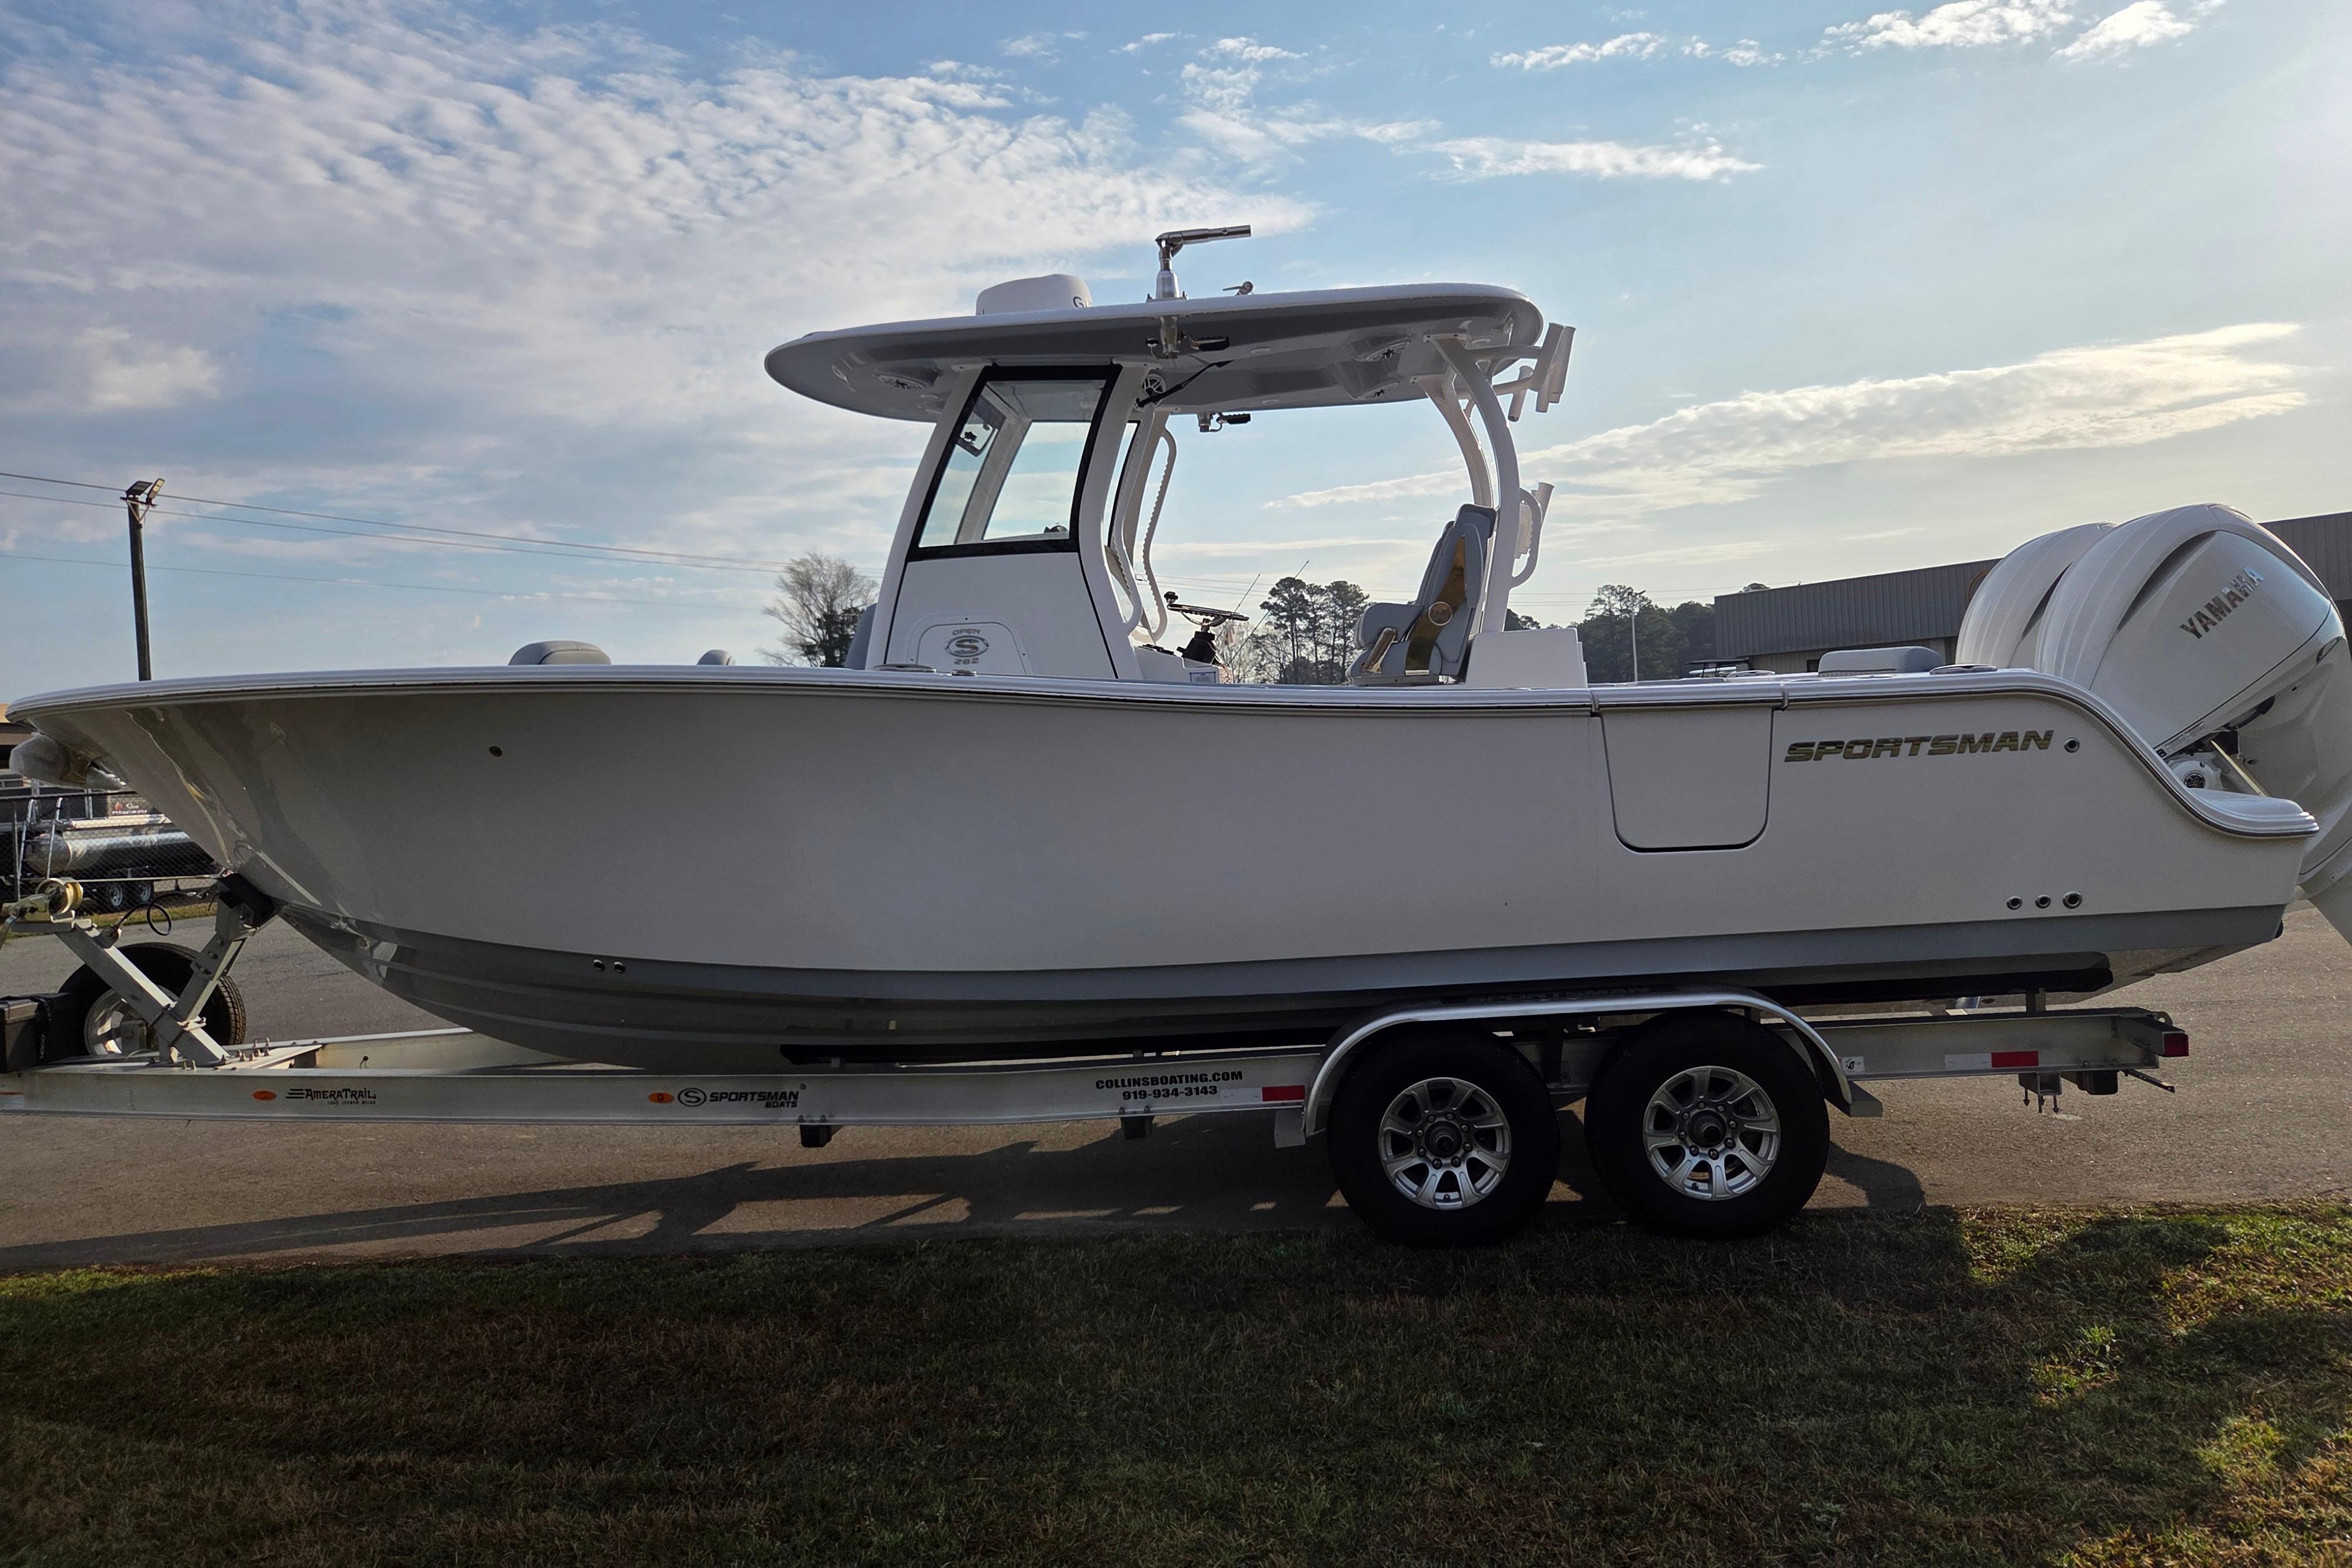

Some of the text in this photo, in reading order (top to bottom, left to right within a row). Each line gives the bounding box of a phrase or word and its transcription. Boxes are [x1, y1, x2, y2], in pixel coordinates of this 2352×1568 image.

[2179, 565, 2265, 640] YAMAHA
[1784, 730, 2054, 763] SPORTSMAN
[1095, 1071, 1243, 1090] COLLINSBOATING.COM
[709, 1091, 799, 1102] SPORTSMAN
[1122, 1085, 1218, 1100] 919-934-3143
[765, 1100, 798, 1108] BOATS
